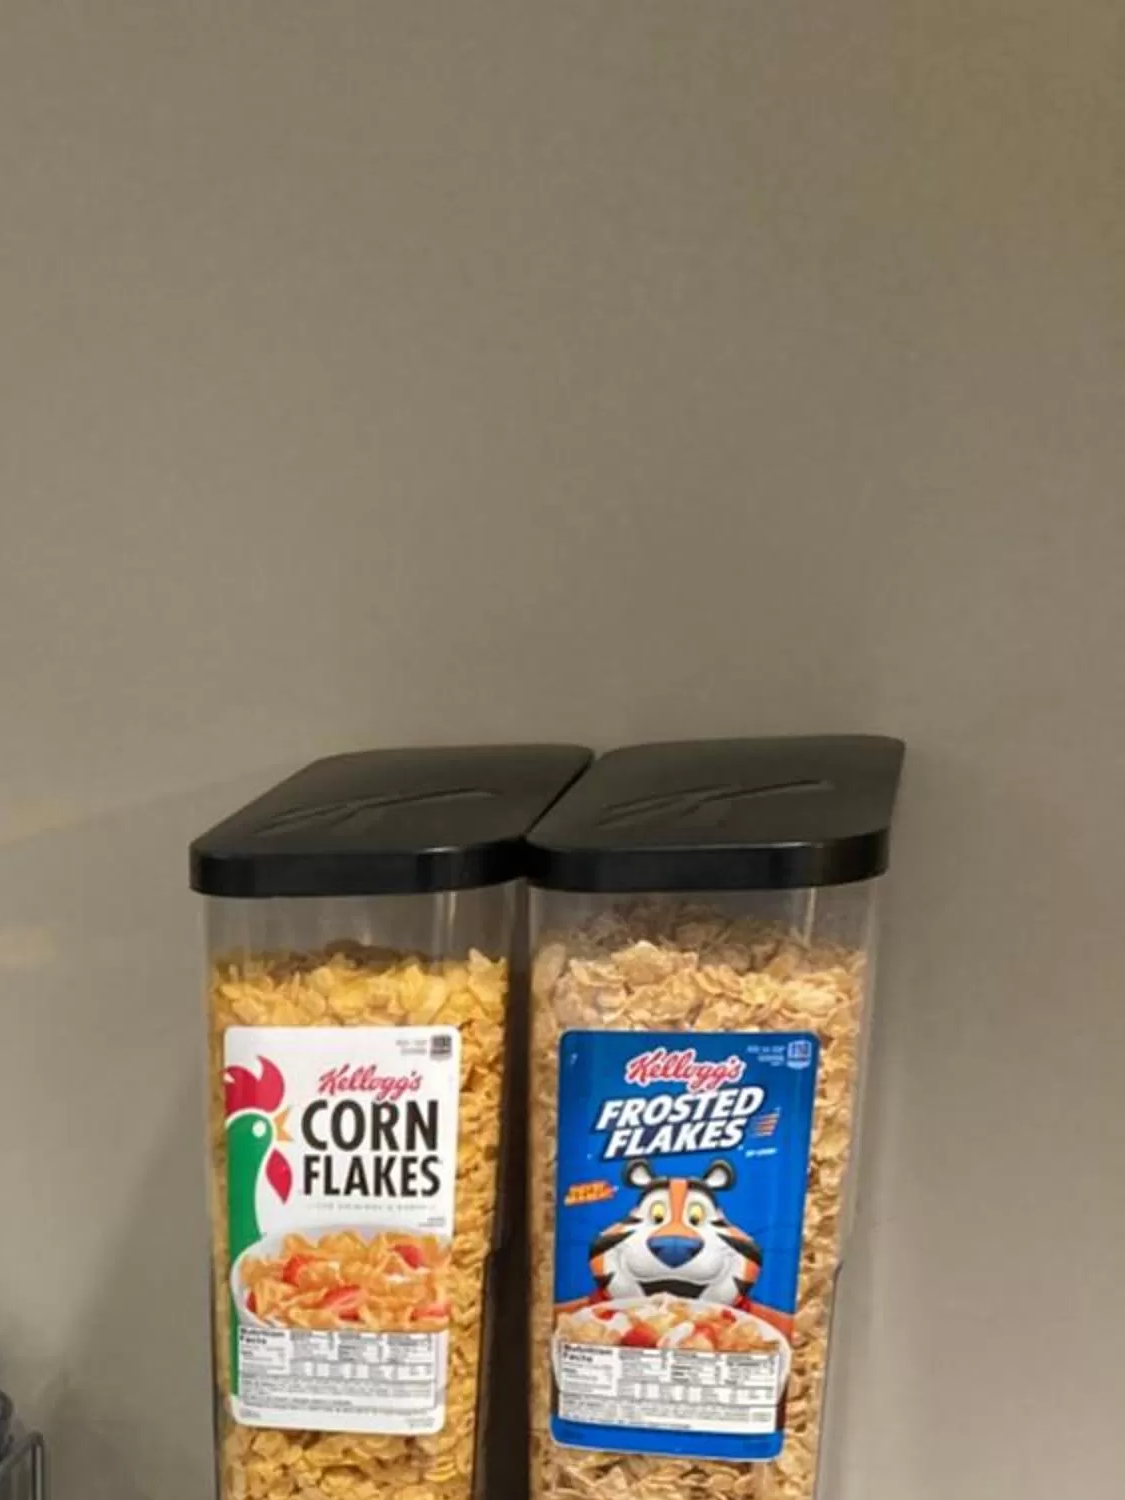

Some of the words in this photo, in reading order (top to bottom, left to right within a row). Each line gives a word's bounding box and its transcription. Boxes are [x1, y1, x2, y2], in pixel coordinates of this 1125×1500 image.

[318, 1063, 424, 1101] Kellogg's
[626, 1048, 745, 1091] Kellogg's
[301, 1099, 439, 1152] CORN
[595, 1087, 765, 1131] FROSTED
[603, 1118, 749, 1160] FLAKES
[302, 1154, 442, 1198] FLAKES
